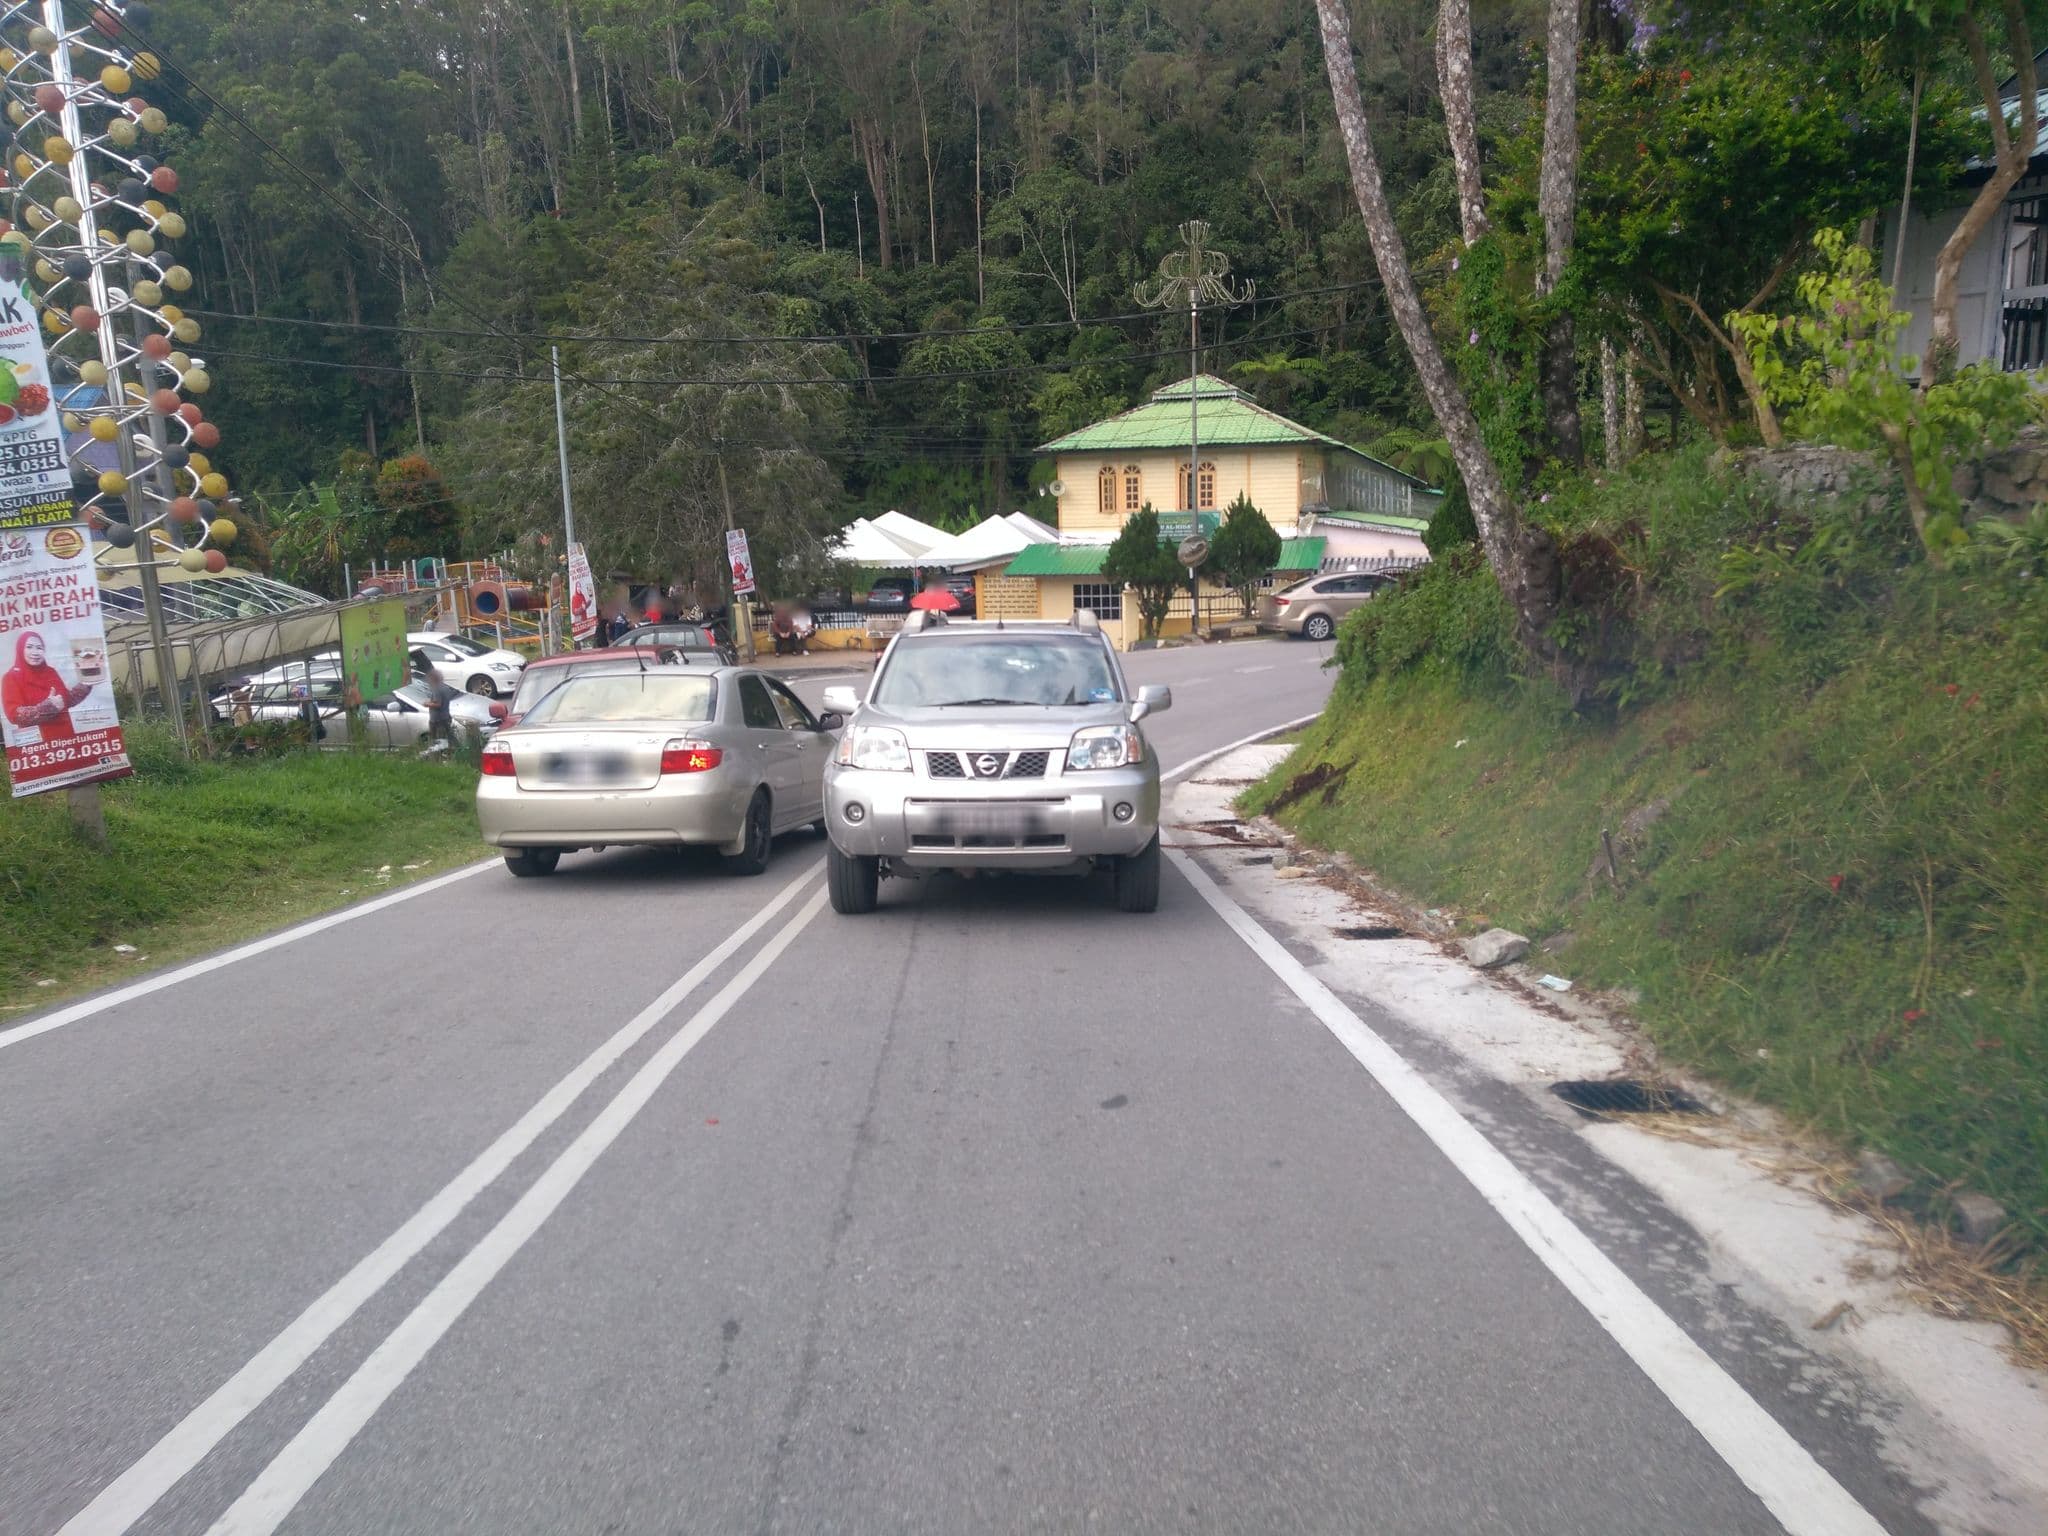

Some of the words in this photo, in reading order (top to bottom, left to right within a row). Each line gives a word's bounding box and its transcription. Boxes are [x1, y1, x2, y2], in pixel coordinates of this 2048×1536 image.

[21, 500, 74, 515] MAYBANK
[36, 491, 67, 505] IKUT
[0, 515, 34, 528] NAH
[37, 509, 73, 524] RATA
[24, 586, 95, 610] MERAH
[0, 611, 44, 633] BARU
[21, 741, 49, 755] Agent
[50, 730, 108, 750] Diperlukan!
[10, 738, 122, 773] 013.392.0315
